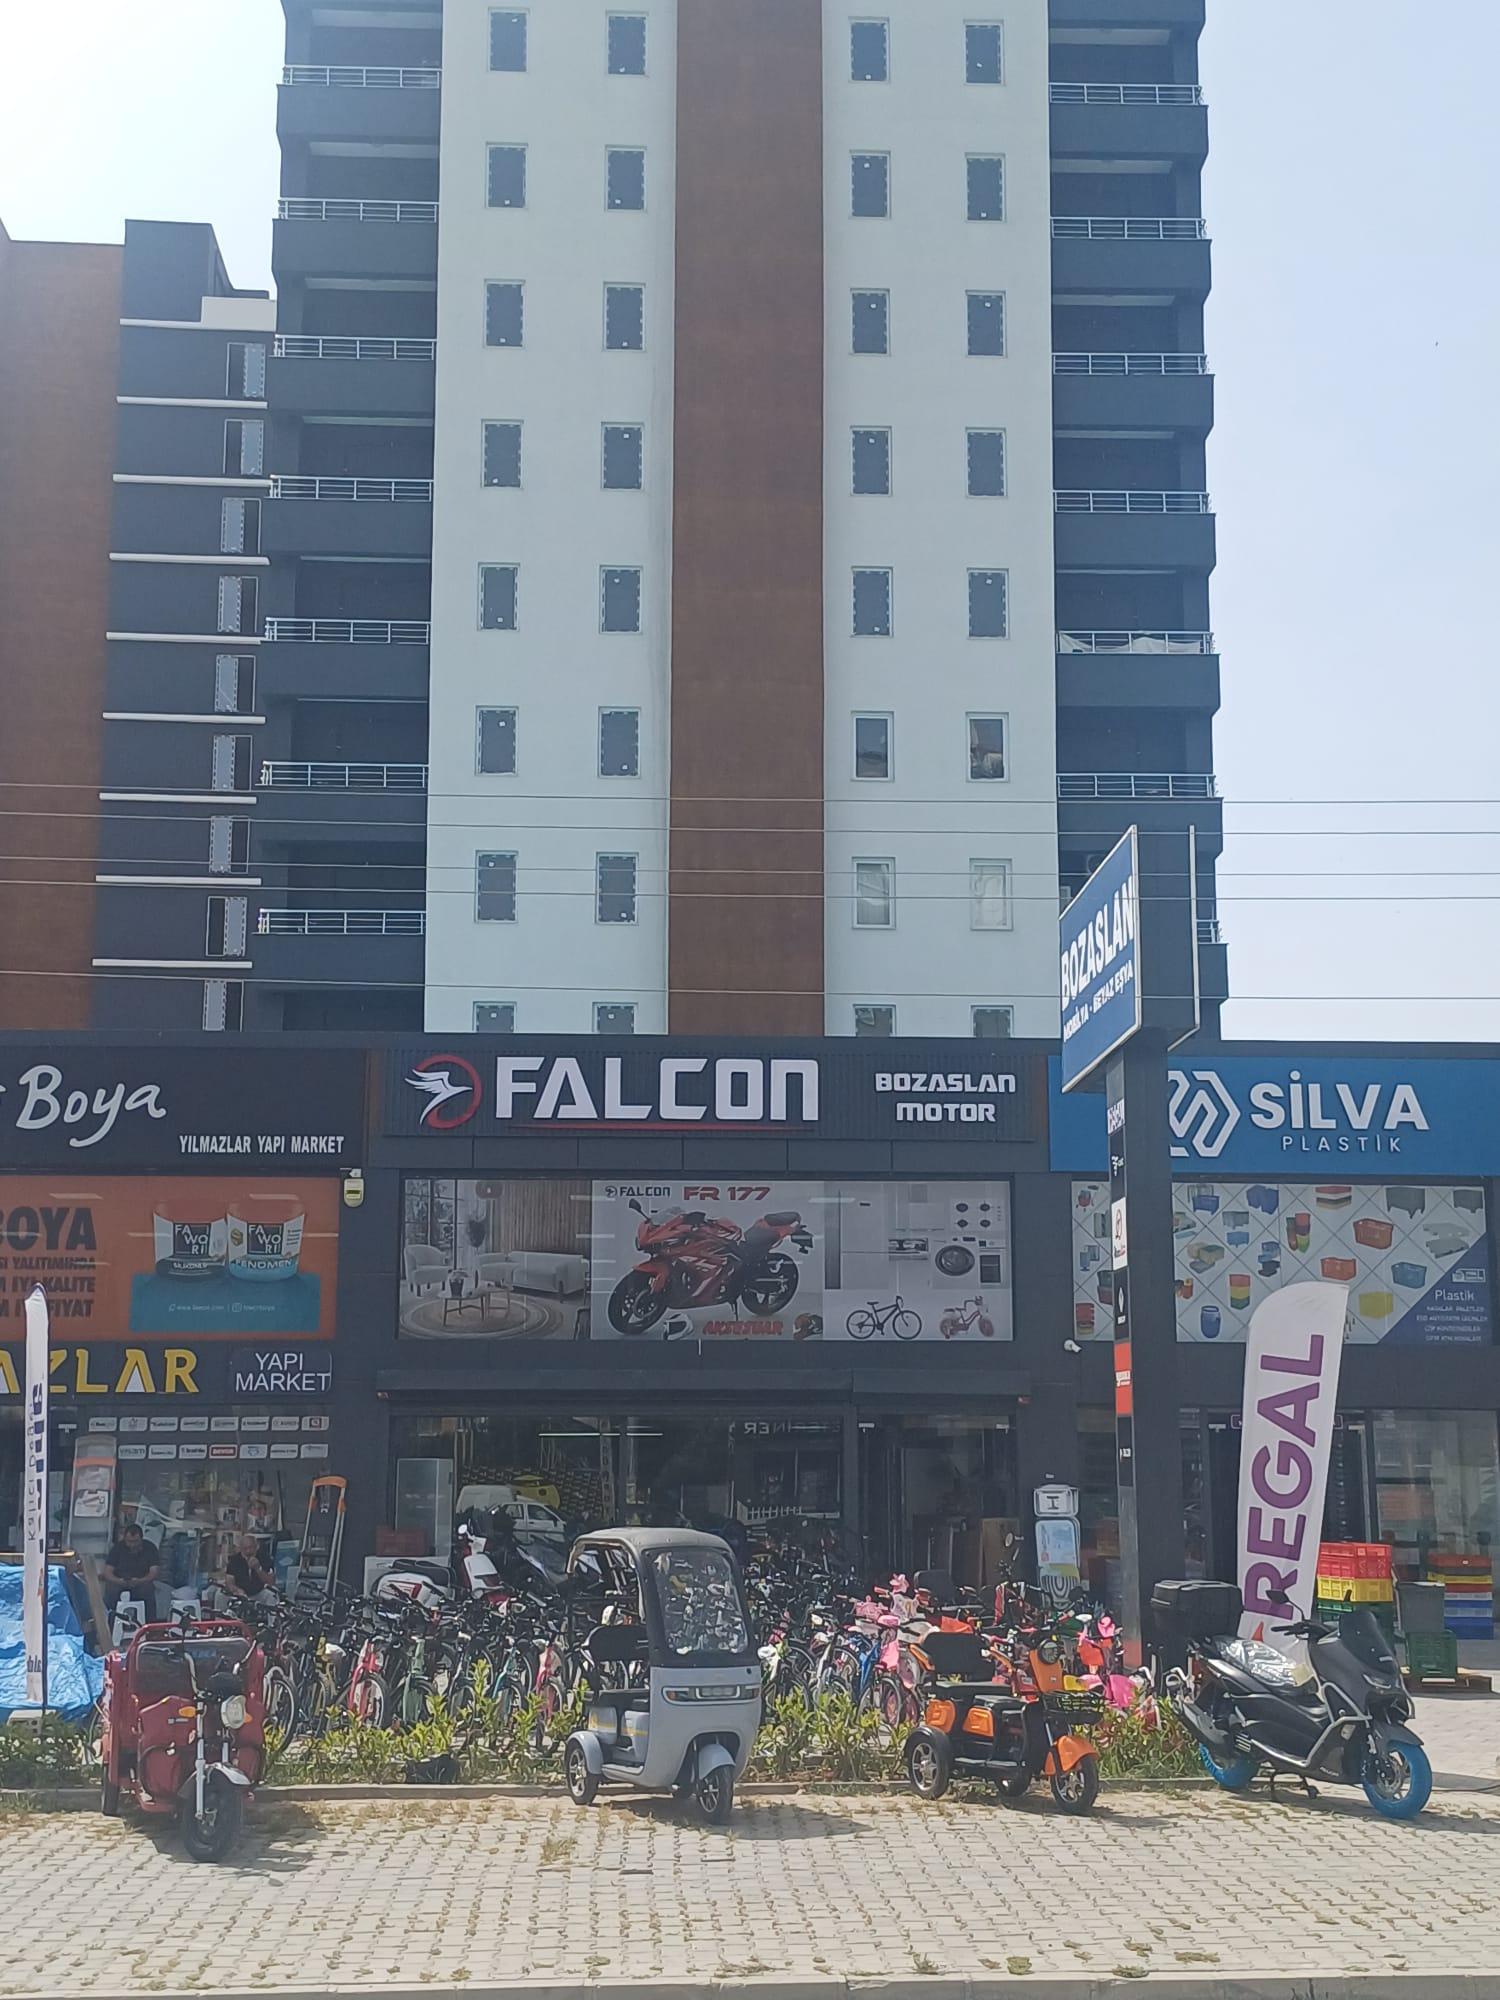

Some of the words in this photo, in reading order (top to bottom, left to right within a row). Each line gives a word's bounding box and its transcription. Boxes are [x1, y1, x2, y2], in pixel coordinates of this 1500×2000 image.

[1061, 875, 1134, 1011] BOZASLAN
[495, 1056, 819, 1122] FALCON
[875, 1073, 1016, 1093] BOZASLAN
[16, 1064, 167, 1148] Boya
[1250, 1070, 1430, 1130] SİLVA
[896, 1102, 996, 1122] MOTOR
[179, 1135, 251, 1153] YILMAZLAR
[258, 1135, 285, 1153] YAPI
[291, 1135, 345, 1153] MARKET
[619, 1186, 671, 1197] FALCON
[727, 1186, 771, 1200] 177
[0, 1206, 97, 1251] OYA
[1435, 1289, 1475, 1301] Plastik
[255, 1352, 303, 1371] YAPI
[235, 1372, 330, 1392] MARKET
[1244, 1334, 1324, 1620] REGAL
